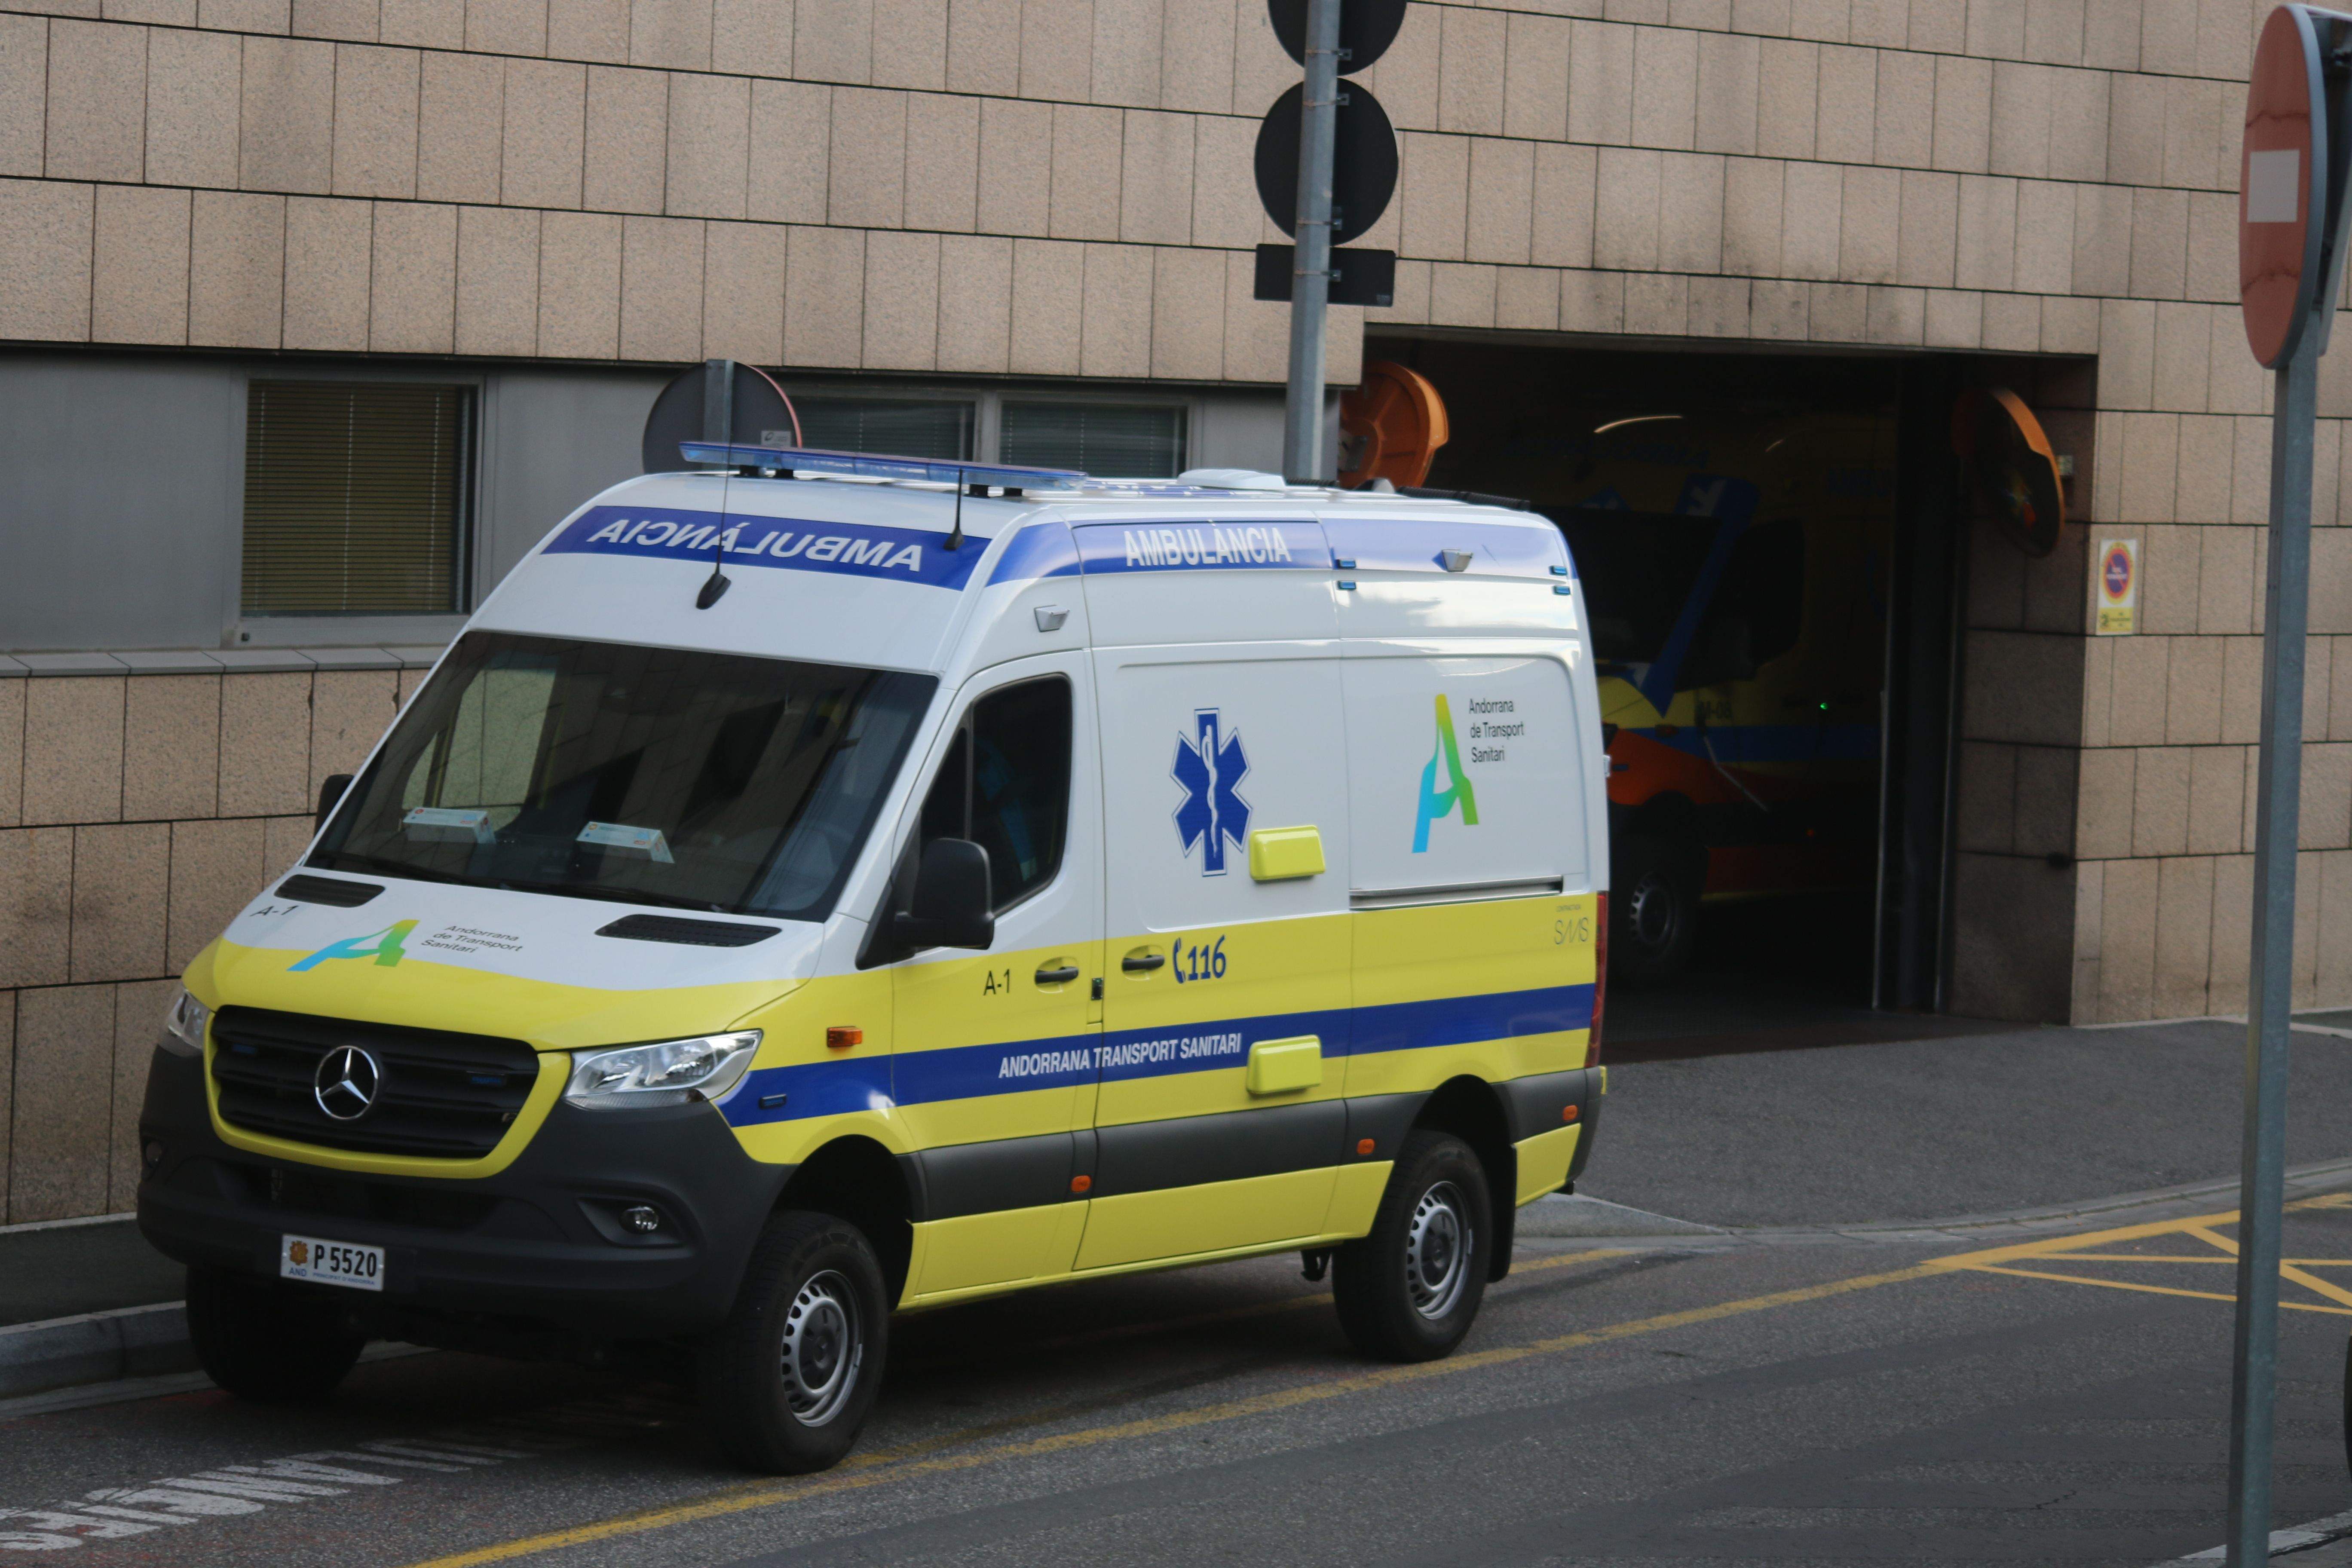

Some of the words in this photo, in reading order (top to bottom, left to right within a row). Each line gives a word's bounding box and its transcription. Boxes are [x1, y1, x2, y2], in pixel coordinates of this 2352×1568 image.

[1469, 698, 1513, 714] Andorrana
[1470, 723, 1481, 738] de
[1483, 721, 1524, 740] Transport
[1472, 745, 1504, 763] Sanitari
[249, 905, 299, 916] A-1
[444, 925, 519, 941] Andorrana
[421, 940, 478, 953] Sanitari
[455, 935, 523, 952] Transport
[1188, 934, 1226, 981] 116
[983, 968, 1011, 996] A-1
[999, 1049, 1090, 1078] ANDORRANA
[1093, 1039, 1178, 1068] TRANSPORT
[1179, 1032, 1242, 1059] SANITARI
[314, 1244, 325, 1269] P
[330, 1246, 377, 1277] 5520
[289, 1268, 307, 1277] AND
